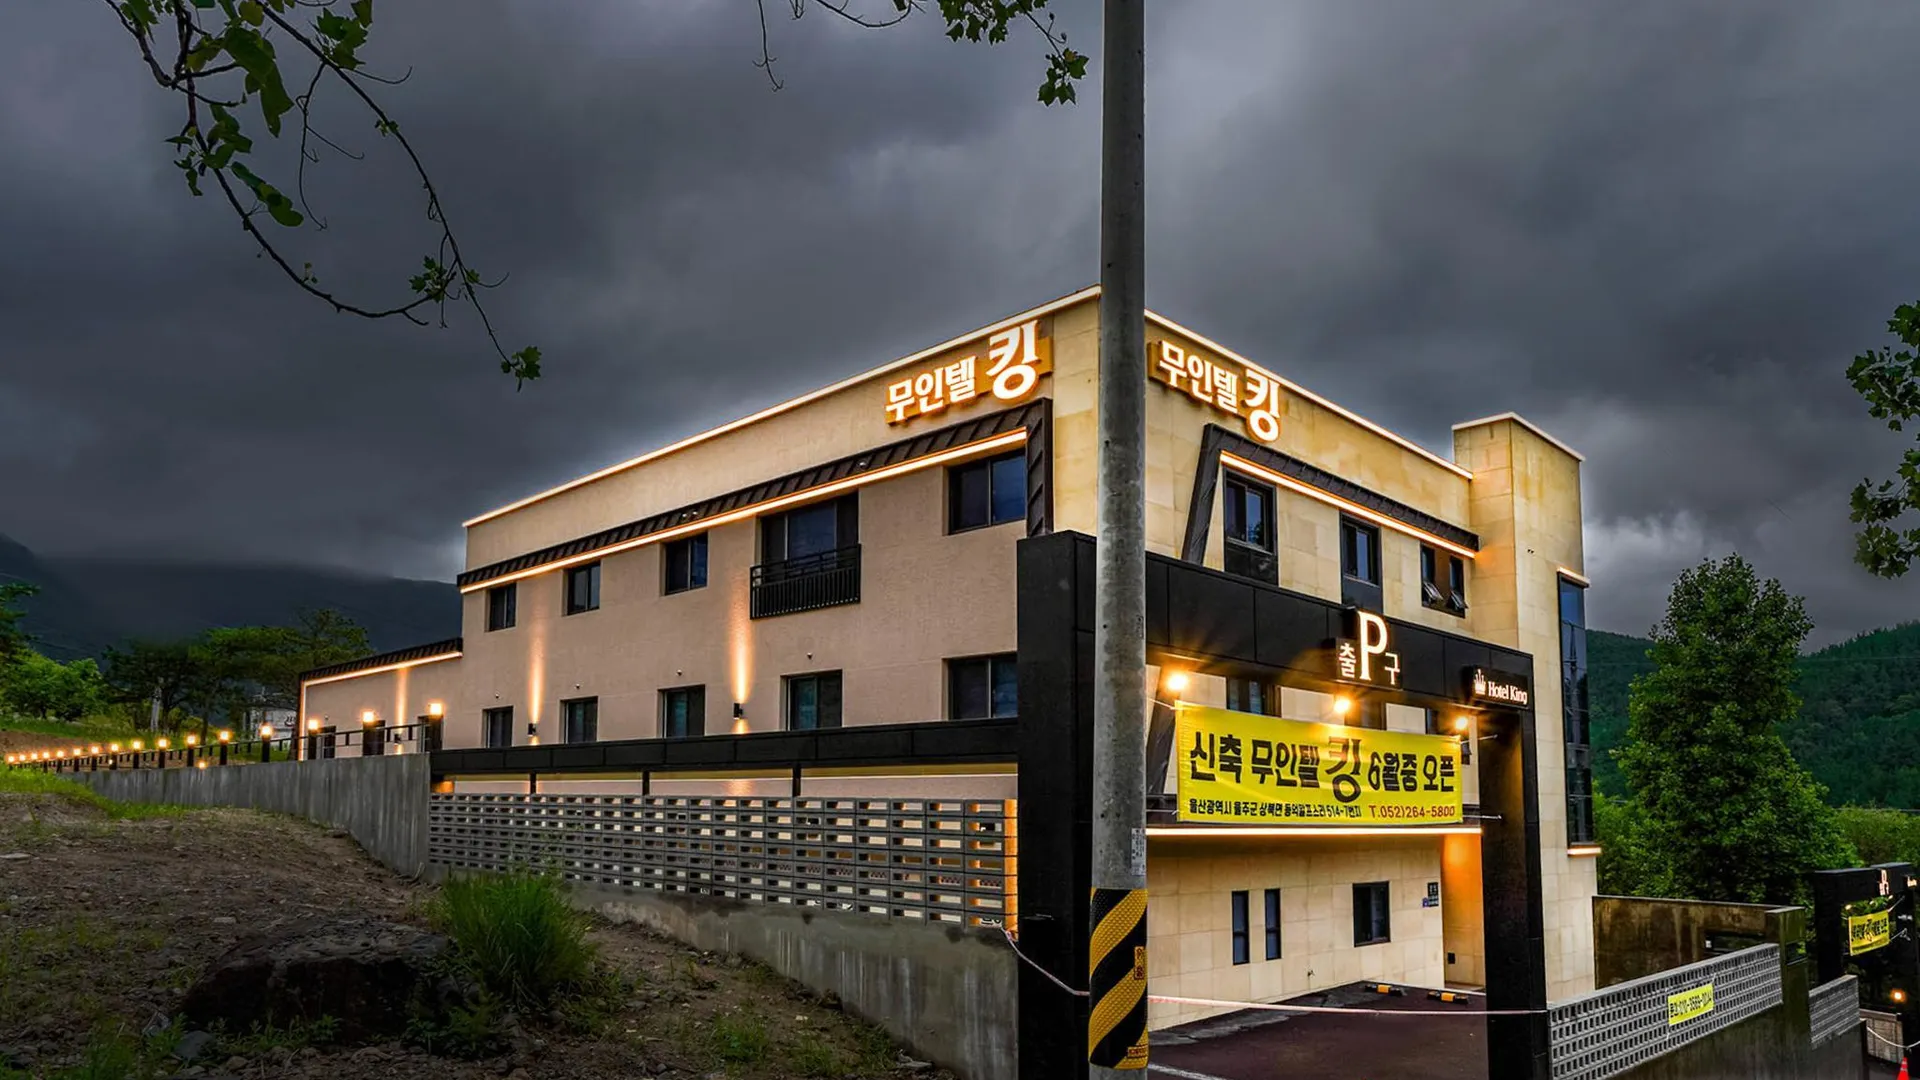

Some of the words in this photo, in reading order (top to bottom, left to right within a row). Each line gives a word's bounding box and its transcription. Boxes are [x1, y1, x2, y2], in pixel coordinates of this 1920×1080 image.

[886, 356, 977, 421] 무인텔
[987, 319, 1039, 399] 킹
[1159, 339, 1237, 412] 무인텔
[1245, 367, 1281, 442] 킹
[1487, 680, 1509, 700] Hotel
[1509, 685, 1528, 705] King
[1190, 731, 1242, 784] 신축
[1251, 738, 1320, 788] 무인텔
[1325, 736, 1362, 803] 킹
[1367, 751, 1417, 792] 6월중
[1423, 754, 1455, 792] 오픈
[1189, 798, 1232, 815] 울산광역시
[1234, 801, 1258, 816] 울주군
[1367, 804, 1456, 819] T.052)264-5800
